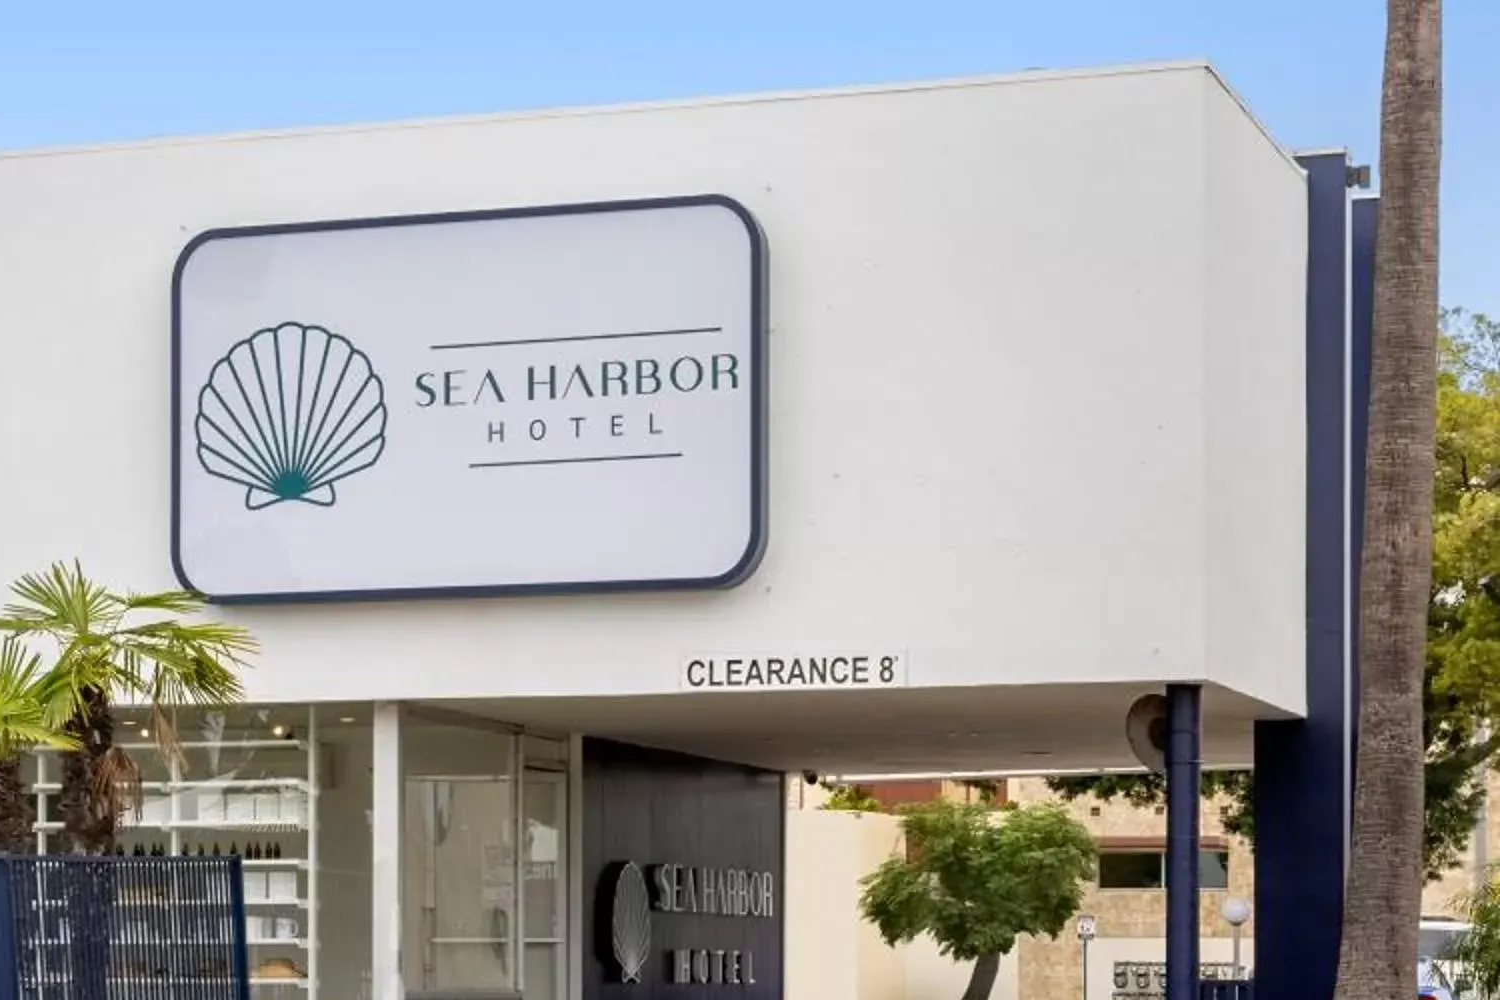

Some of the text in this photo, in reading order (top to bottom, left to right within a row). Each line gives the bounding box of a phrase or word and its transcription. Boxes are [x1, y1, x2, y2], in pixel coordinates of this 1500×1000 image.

[415, 353, 740, 407] SEA HARBOR
[487, 412, 663, 443] HOTEL
[687, 656, 869, 687] CLEARANCE
[656, 863, 774, 917] SEA HARBOR
[674, 949, 757, 984] HOTEL
